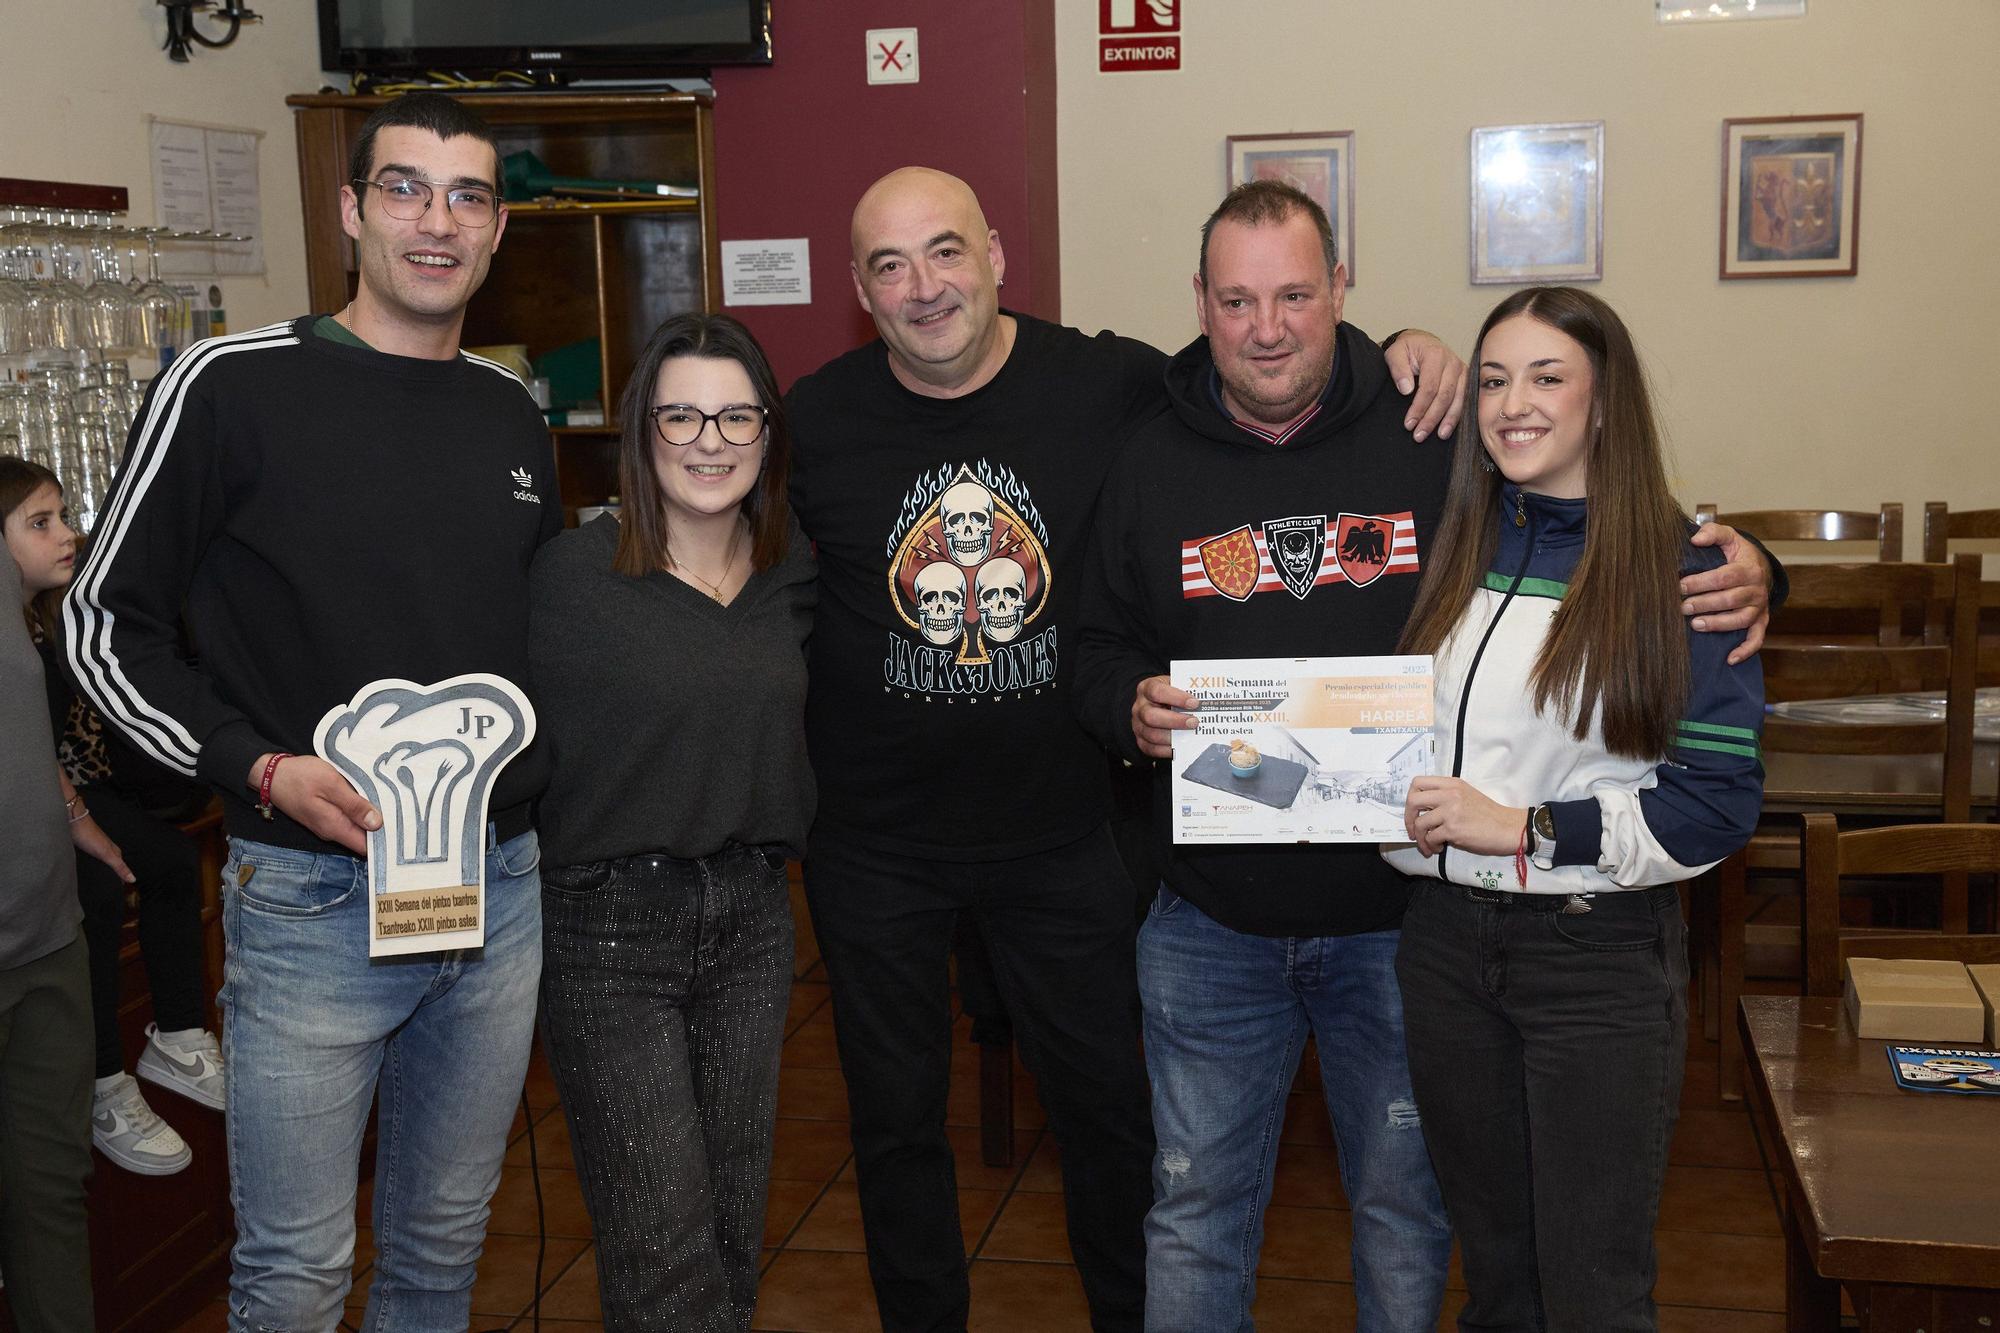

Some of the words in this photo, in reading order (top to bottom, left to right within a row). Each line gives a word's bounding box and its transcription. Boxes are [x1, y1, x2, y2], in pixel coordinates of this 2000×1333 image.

[1104, 46, 1176, 61] EXTINTOR
[513, 490, 540, 504] adidas
[1268, 520, 1302, 531] ATHLETIC
[1302, 518, 1322, 527] CLUB
[1285, 571, 1314, 594] BILBAO
[884, 631, 953, 693] JACK
[973, 625, 1058, 694] JONES
[1240, 689, 1290, 699] Txantrea
[1230, 727, 1253, 735] astea
[1481, 878, 1498, 889] 19
[378, 900, 394, 914] XXIII
[395, 898, 420, 913] Semana
[421, 896, 431, 910] del
[433, 895, 451, 912] pintxo
[452, 893, 478, 907] txantrea
[378, 920, 416, 935] Txantreako
[417, 918, 435, 932] XXIII
[436, 916, 457, 933] pintxo
[459, 914, 478, 928] astea
